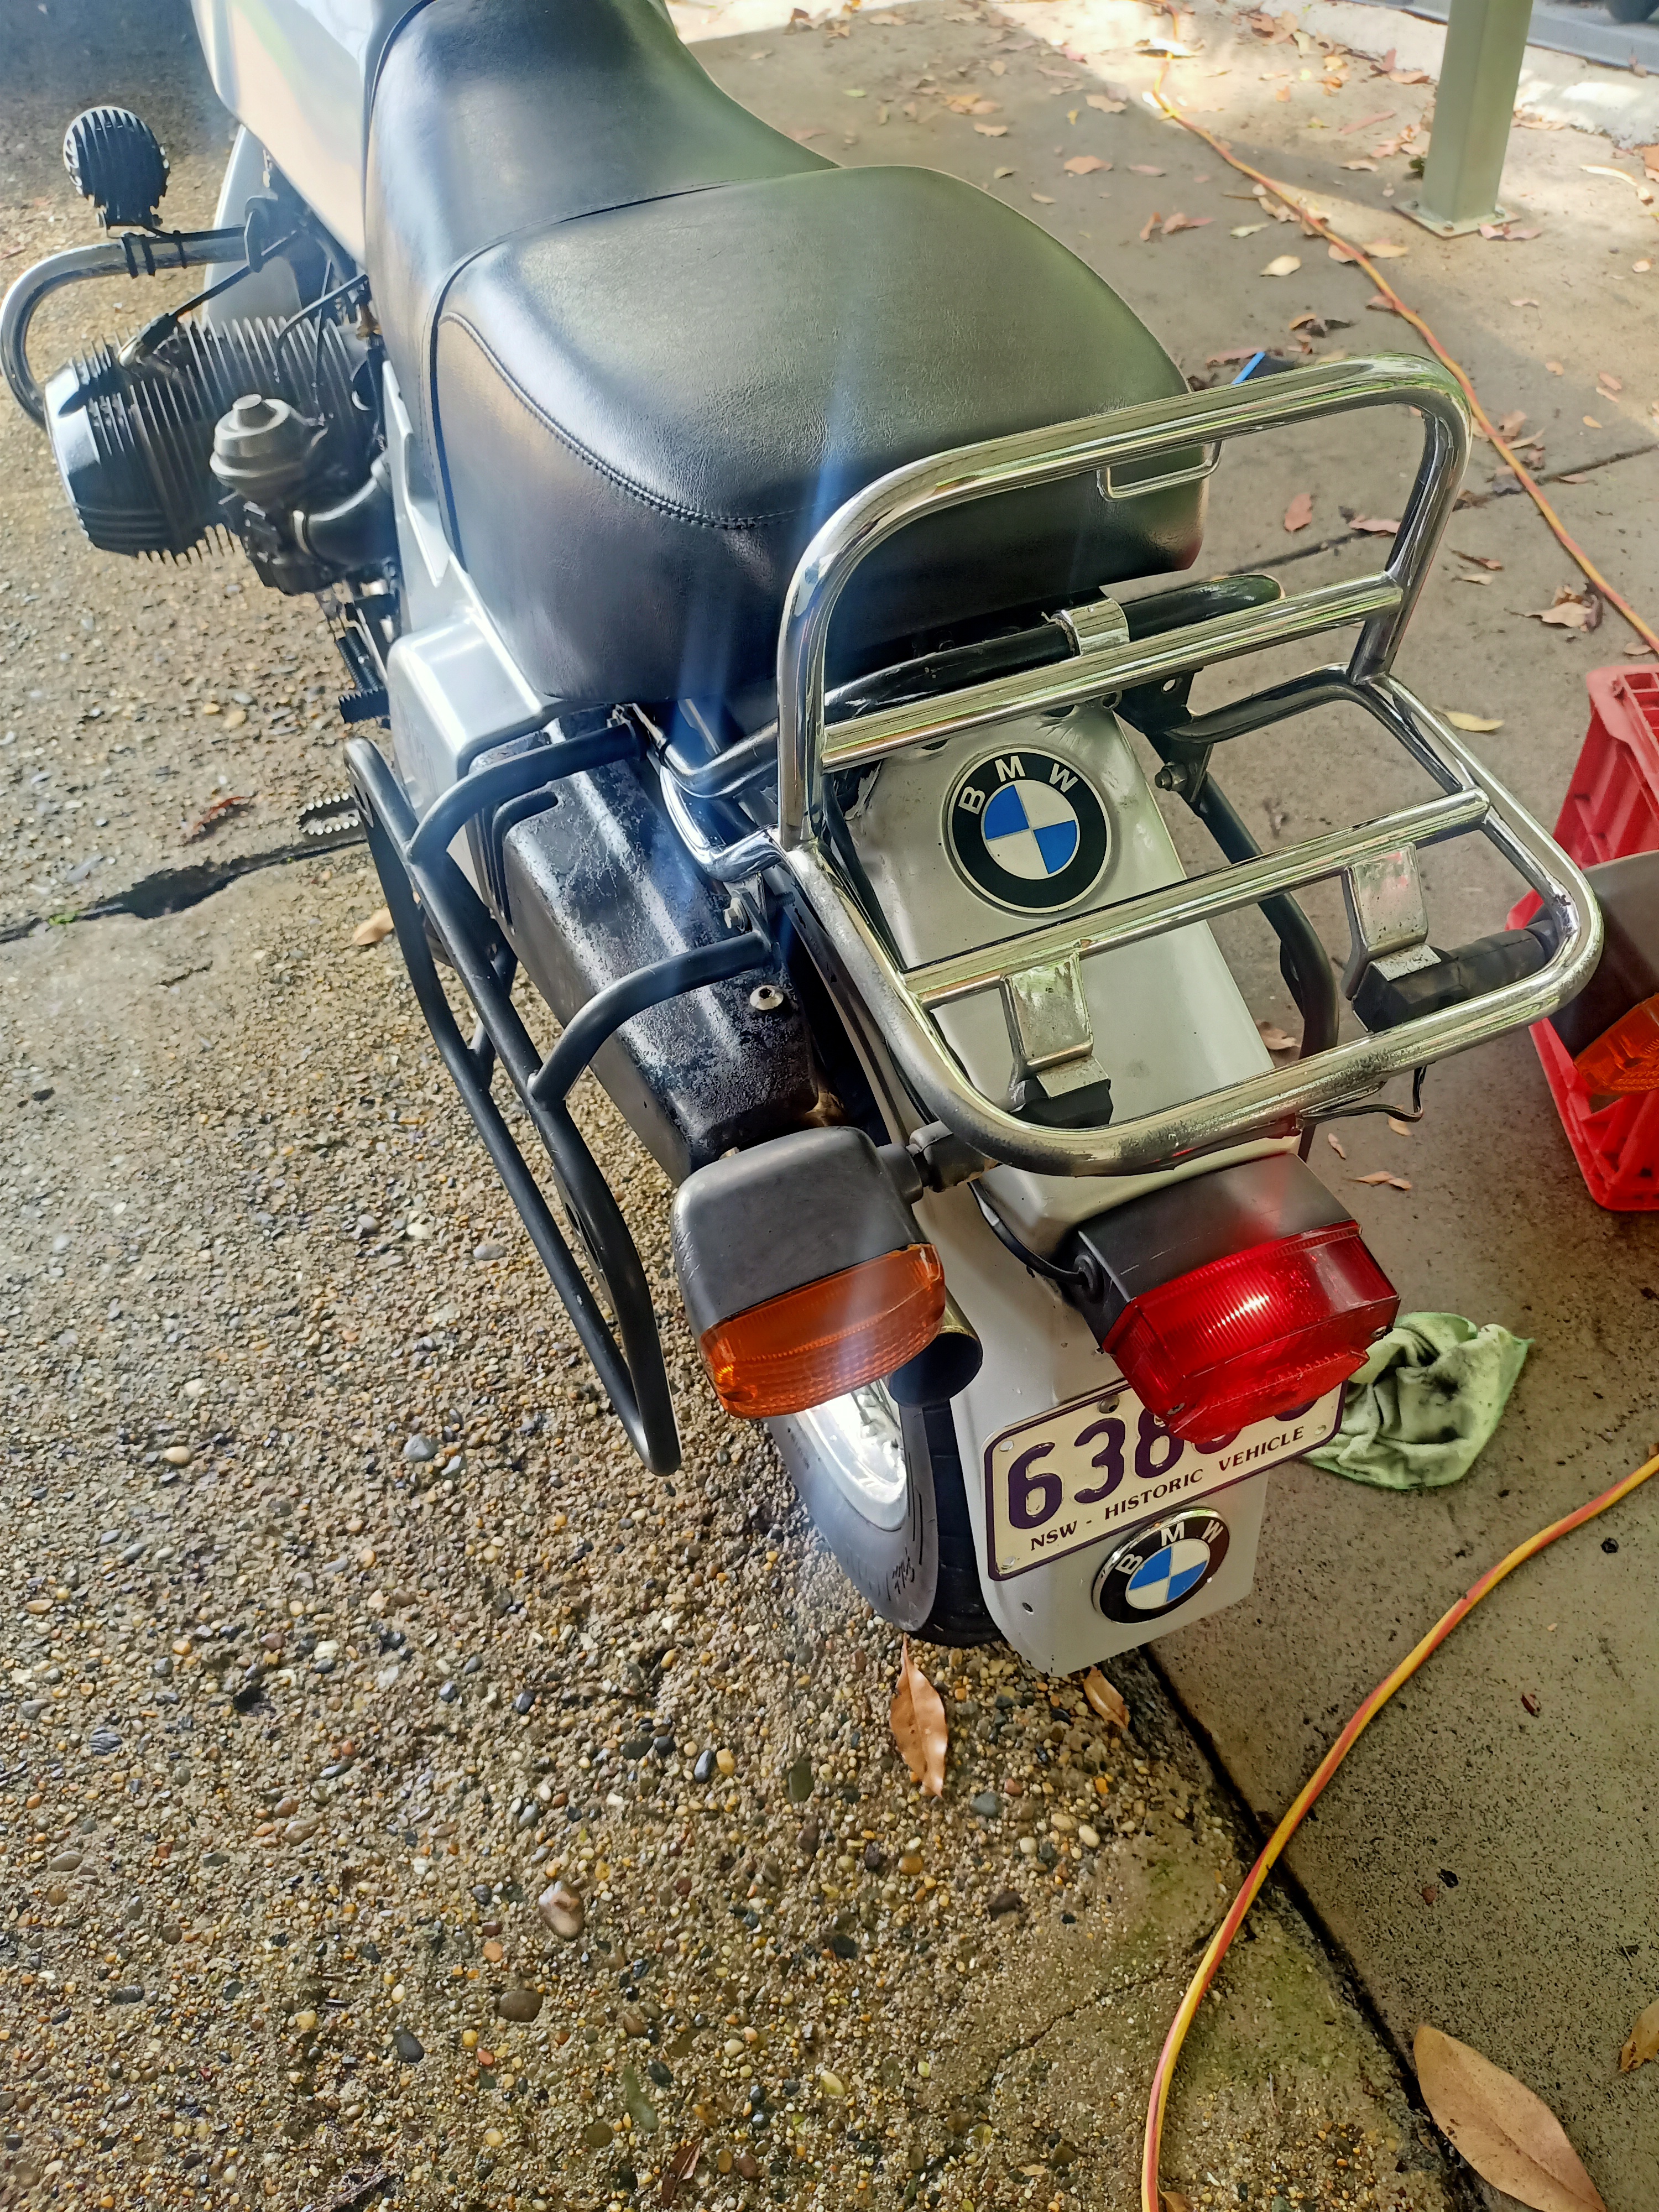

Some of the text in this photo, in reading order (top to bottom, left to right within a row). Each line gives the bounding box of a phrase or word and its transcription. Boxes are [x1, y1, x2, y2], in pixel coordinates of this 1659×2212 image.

[958, 755, 1079, 815] BMW
[1008, 1397, 1319, 1529] 638
[1030, 1519, 1078, 1551] NSW
[1104, 1469, 1203, 1521] HISTORIC
[1219, 1426, 1304, 1472] VEHICLE
[1115, 1519, 1224, 1575] BMW
